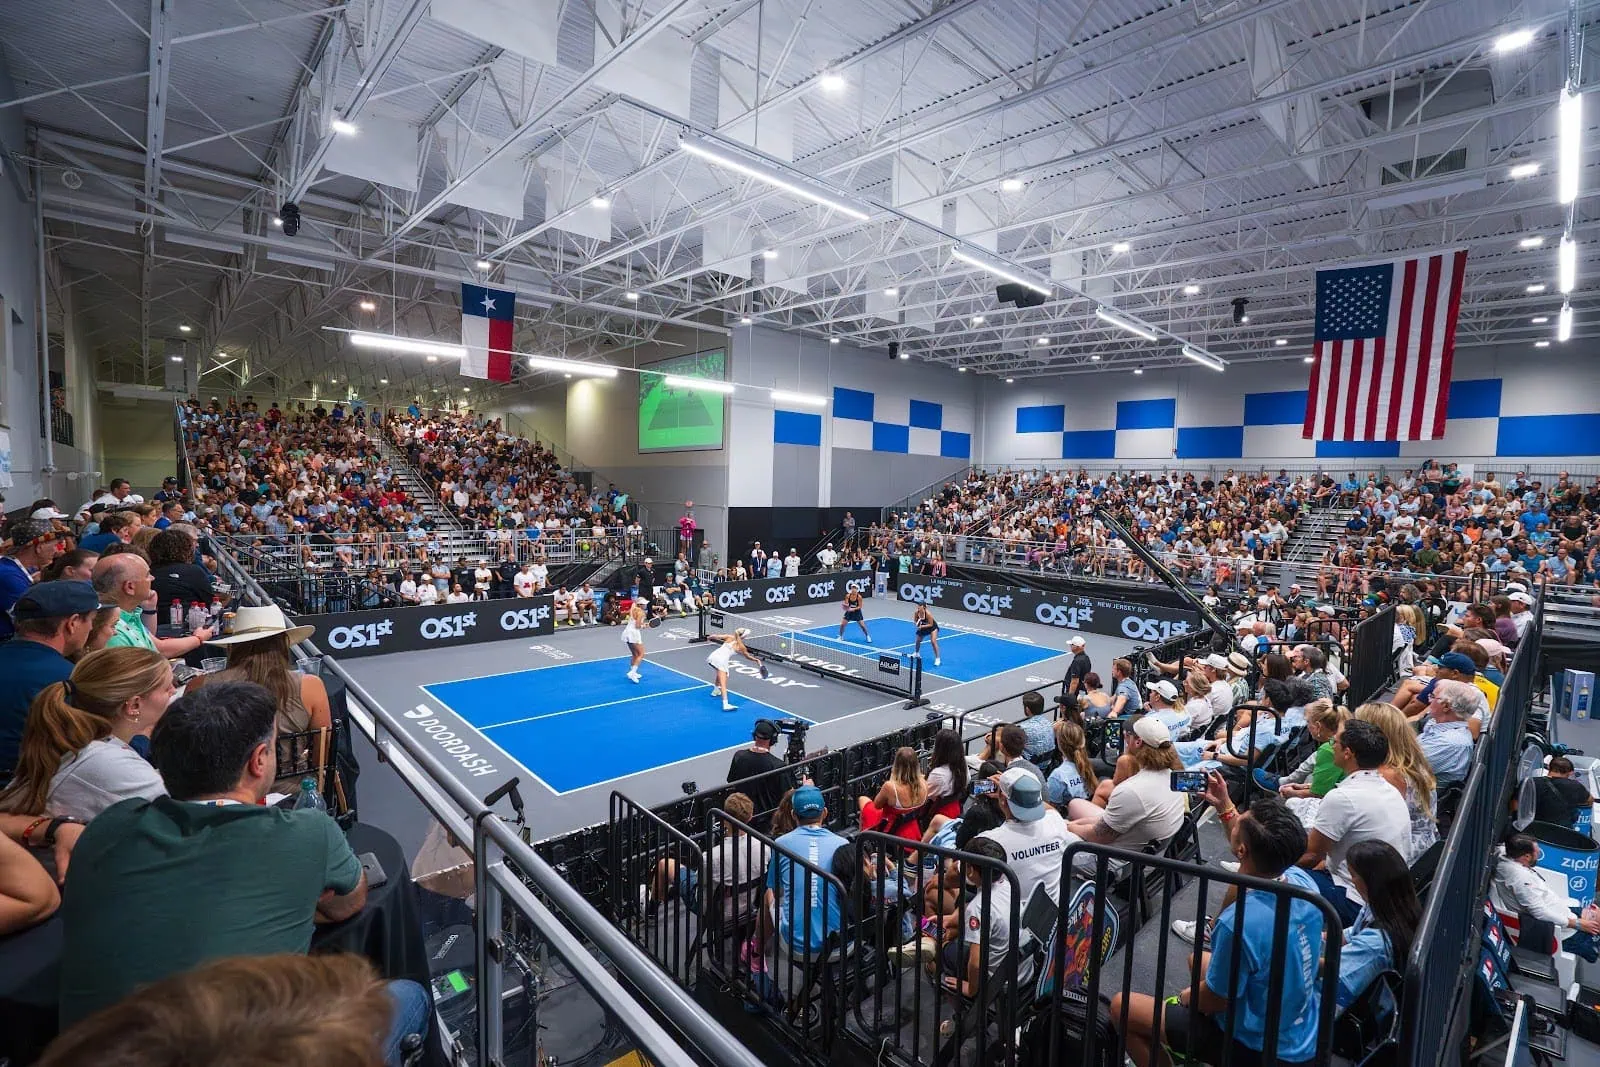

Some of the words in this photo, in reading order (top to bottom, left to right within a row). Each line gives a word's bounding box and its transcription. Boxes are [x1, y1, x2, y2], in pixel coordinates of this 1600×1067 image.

[718, 587, 753, 608] OS1st
[765, 583, 796, 604] OS1st
[807, 579, 835, 599] OS1st
[900, 583, 944, 604] OS1st
[962, 592, 1014, 616] OS1st
[1035, 602, 1095, 629] OS1st
[1097, 601, 1111, 609] NEW
[1112, 603, 1136, 612] JERSEY
[420, 611, 478, 640] OS1st
[500, 604, 551, 632] OS1st
[1121, 615, 1192, 643] OS1st
[328, 618, 394, 650] OS1st
[417, 716, 500, 778] DOORDASH
[1011, 840, 1061, 861] VOLUNTEER
